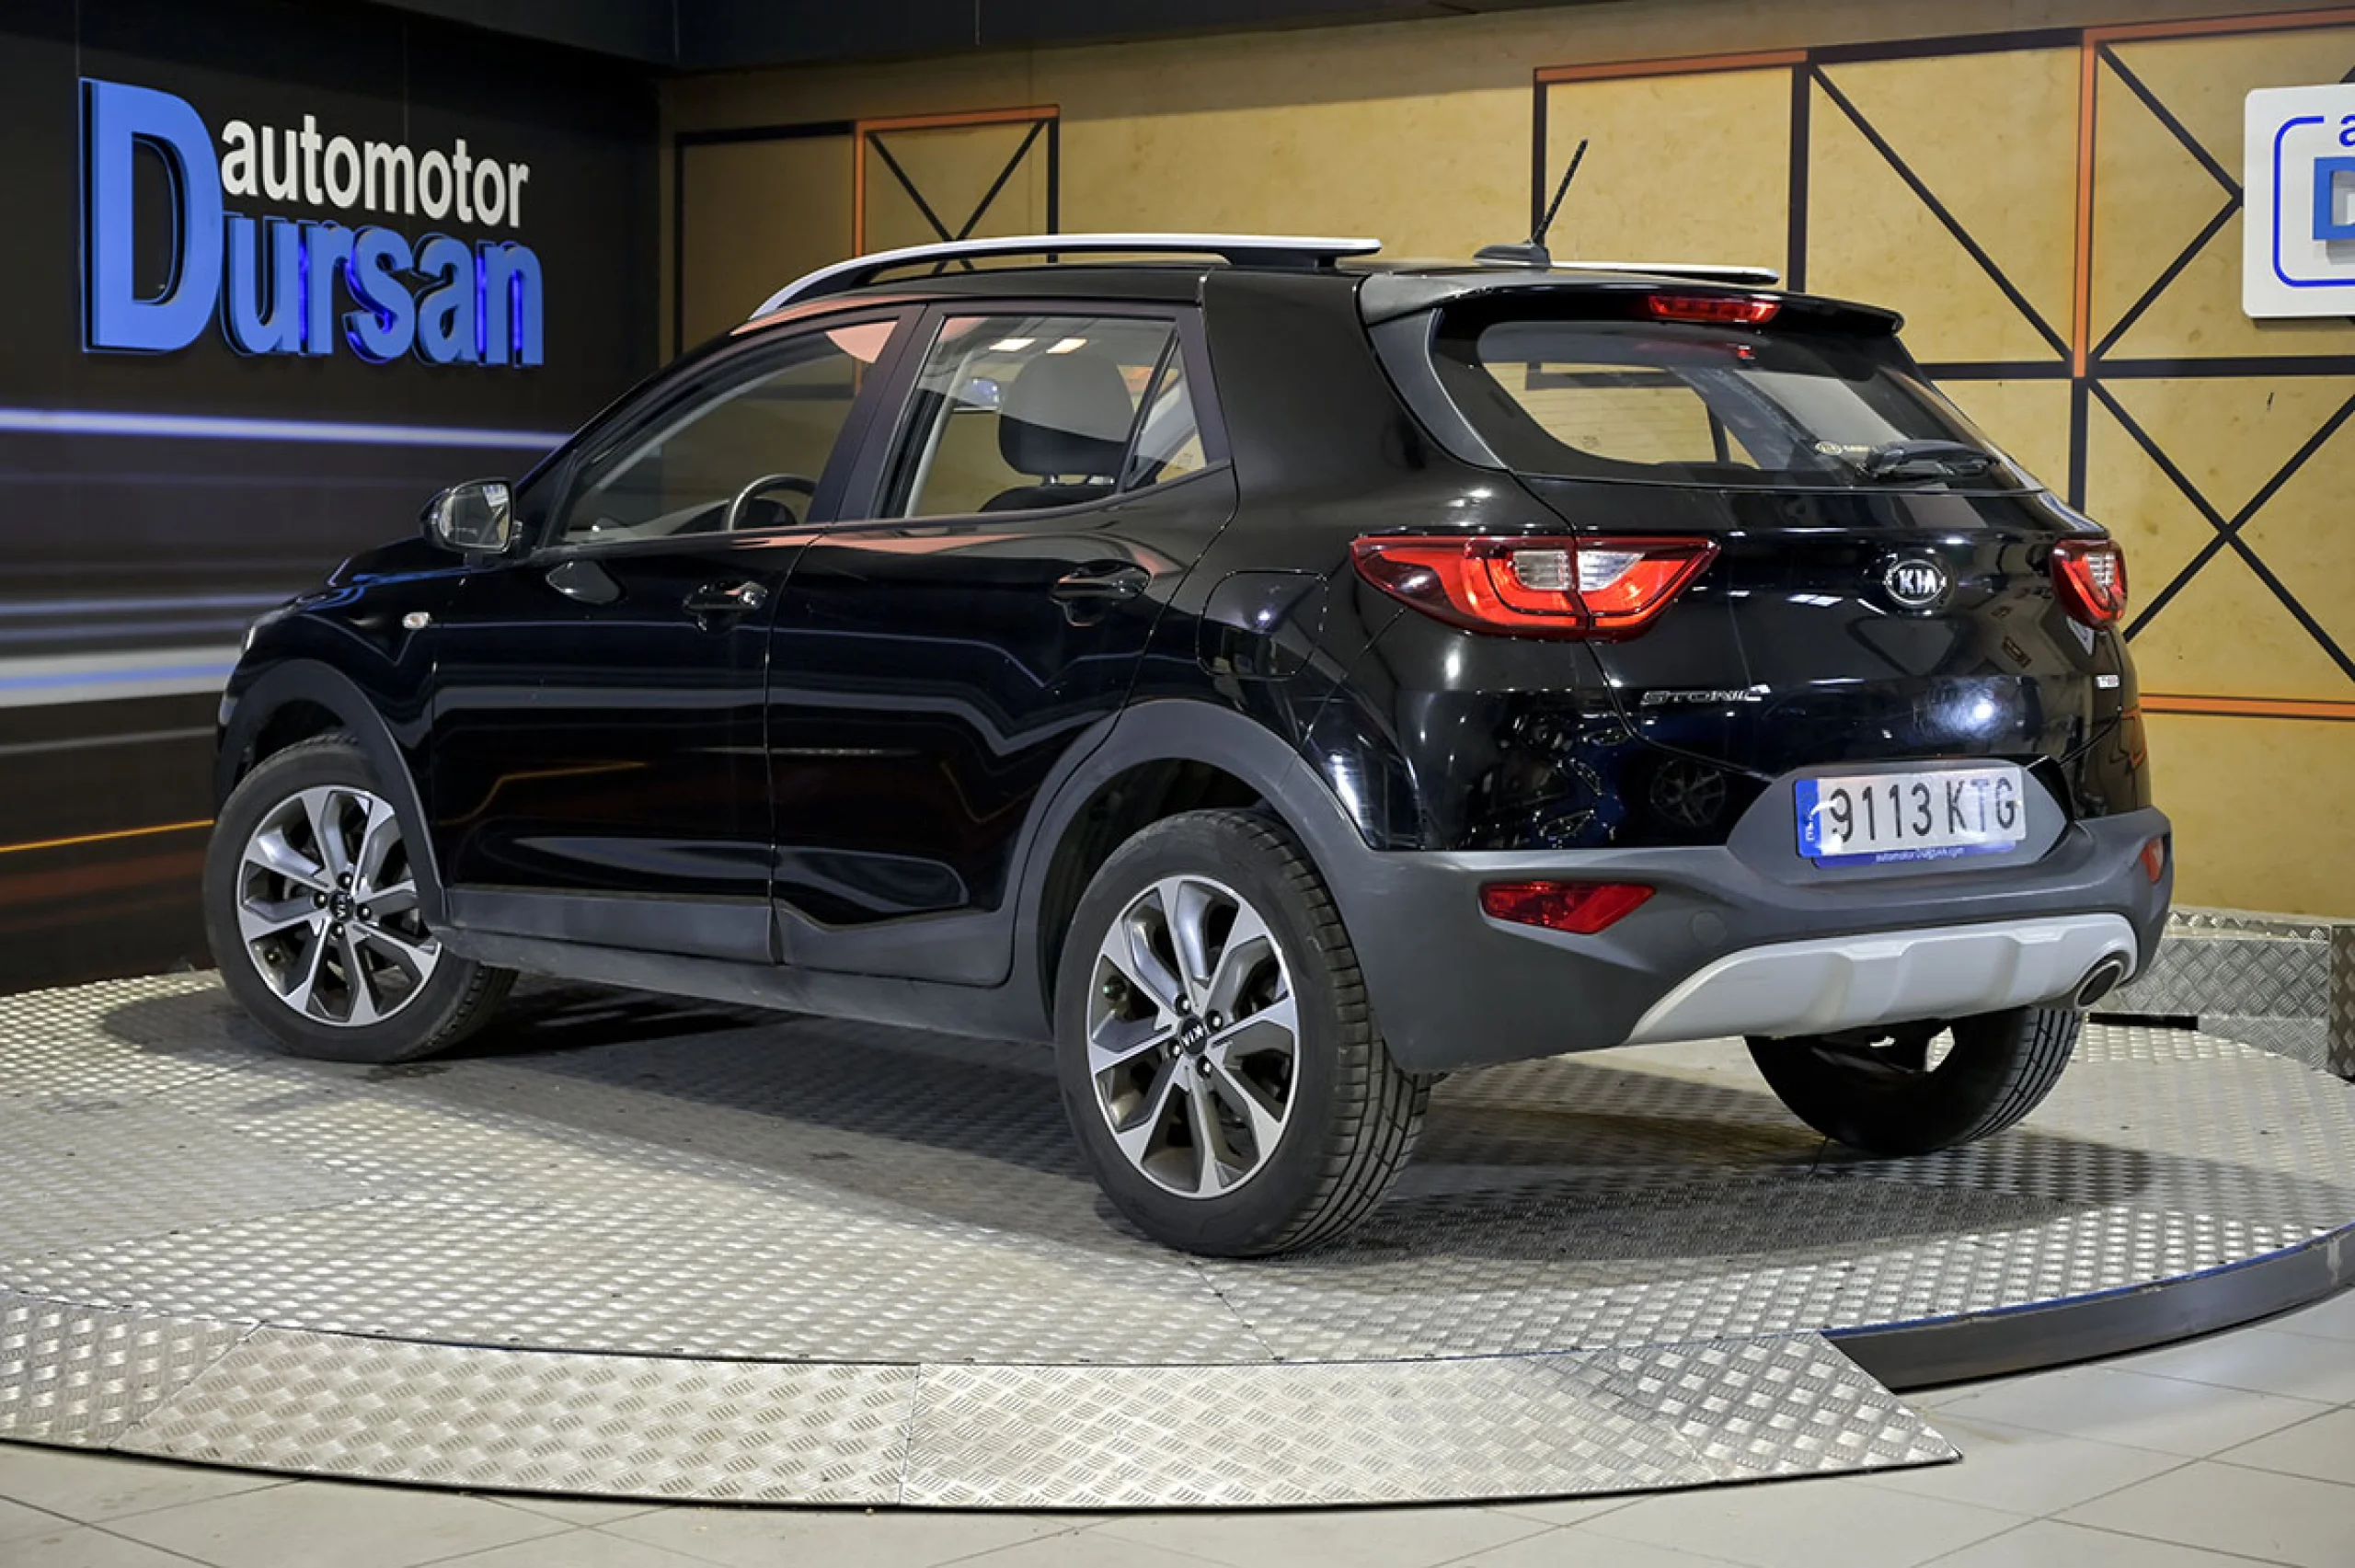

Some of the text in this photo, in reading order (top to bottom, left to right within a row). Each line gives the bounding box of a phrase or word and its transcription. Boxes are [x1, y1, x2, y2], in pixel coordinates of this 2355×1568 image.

[221, 113, 529, 229] automotor
[78, 76, 545, 367] Dursan
[1898, 568, 1936, 595] KIA
[1828, 776, 2016, 843] 9113 KTG
